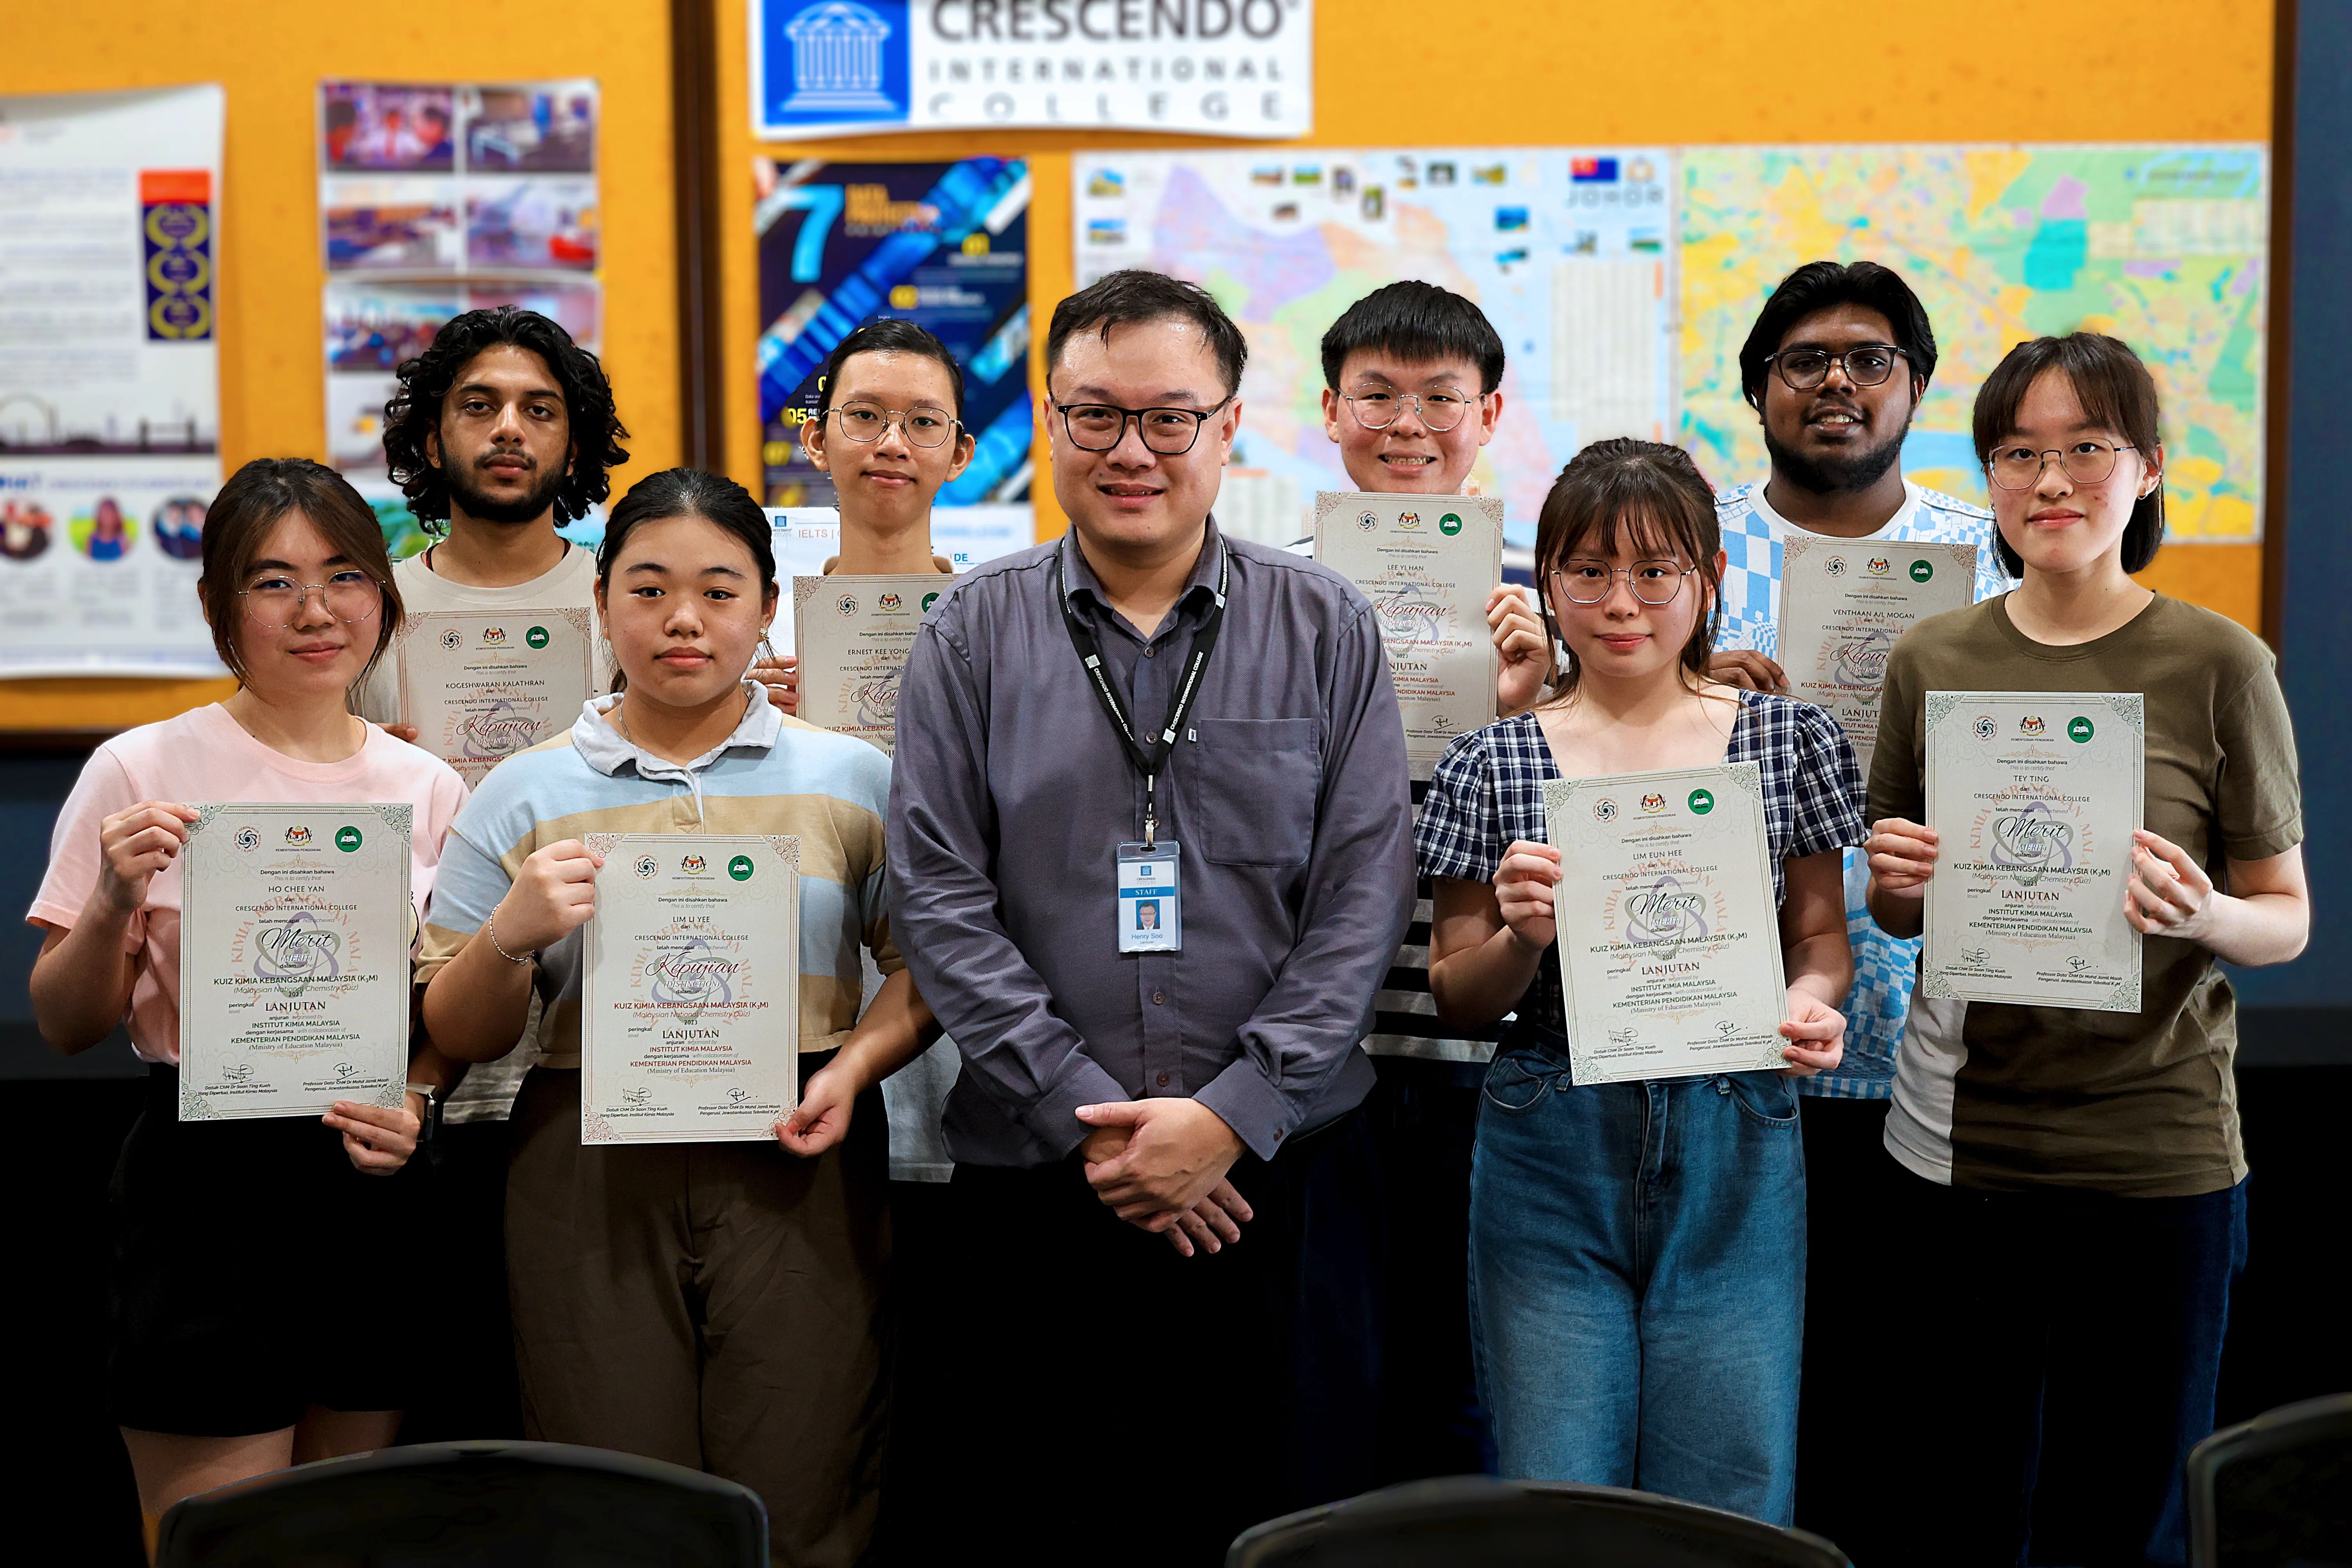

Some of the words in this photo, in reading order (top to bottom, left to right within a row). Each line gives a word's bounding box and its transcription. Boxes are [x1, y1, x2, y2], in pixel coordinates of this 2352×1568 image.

[931, 0, 1283, 42] CRESCENDO
[929, 57, 1284, 83] INTERNATIONAL
[930, 92, 1283, 121] COLLEGE
[777, 183, 845, 283] 7
[798, 530, 828, 538] IELTS
[1171, 704, 1183, 730] CRESCENDO
[1180, 671, 1196, 704] INTERNATIONAL
[1193, 651, 1203, 671] COLLEGE
[456, 713, 543, 736] Kepujian
[1998, 816, 2068, 838] Merit
[1641, 868, 1689, 877] INTERNATIONAL
[1630, 892, 1700, 915] Merit
[2002, 890, 2059, 901] LANJUTAN
[262, 927, 336, 949] Merit
[1633, 938, 1686, 949] KEBANGSAAN
[1688, 935, 1725, 944] MALAYSIA
[646, 951, 740, 979] Kepujian
[1642, 962, 1700, 975] LANJUTAN
[265, 1002, 326, 1012] LANJUTAN
[1613, 999, 1660, 1008] KEMENTERIAN
[1662, 995, 1702, 1004] PENDIDIKAN
[663, 1030, 719, 1040] LANJUTAN
